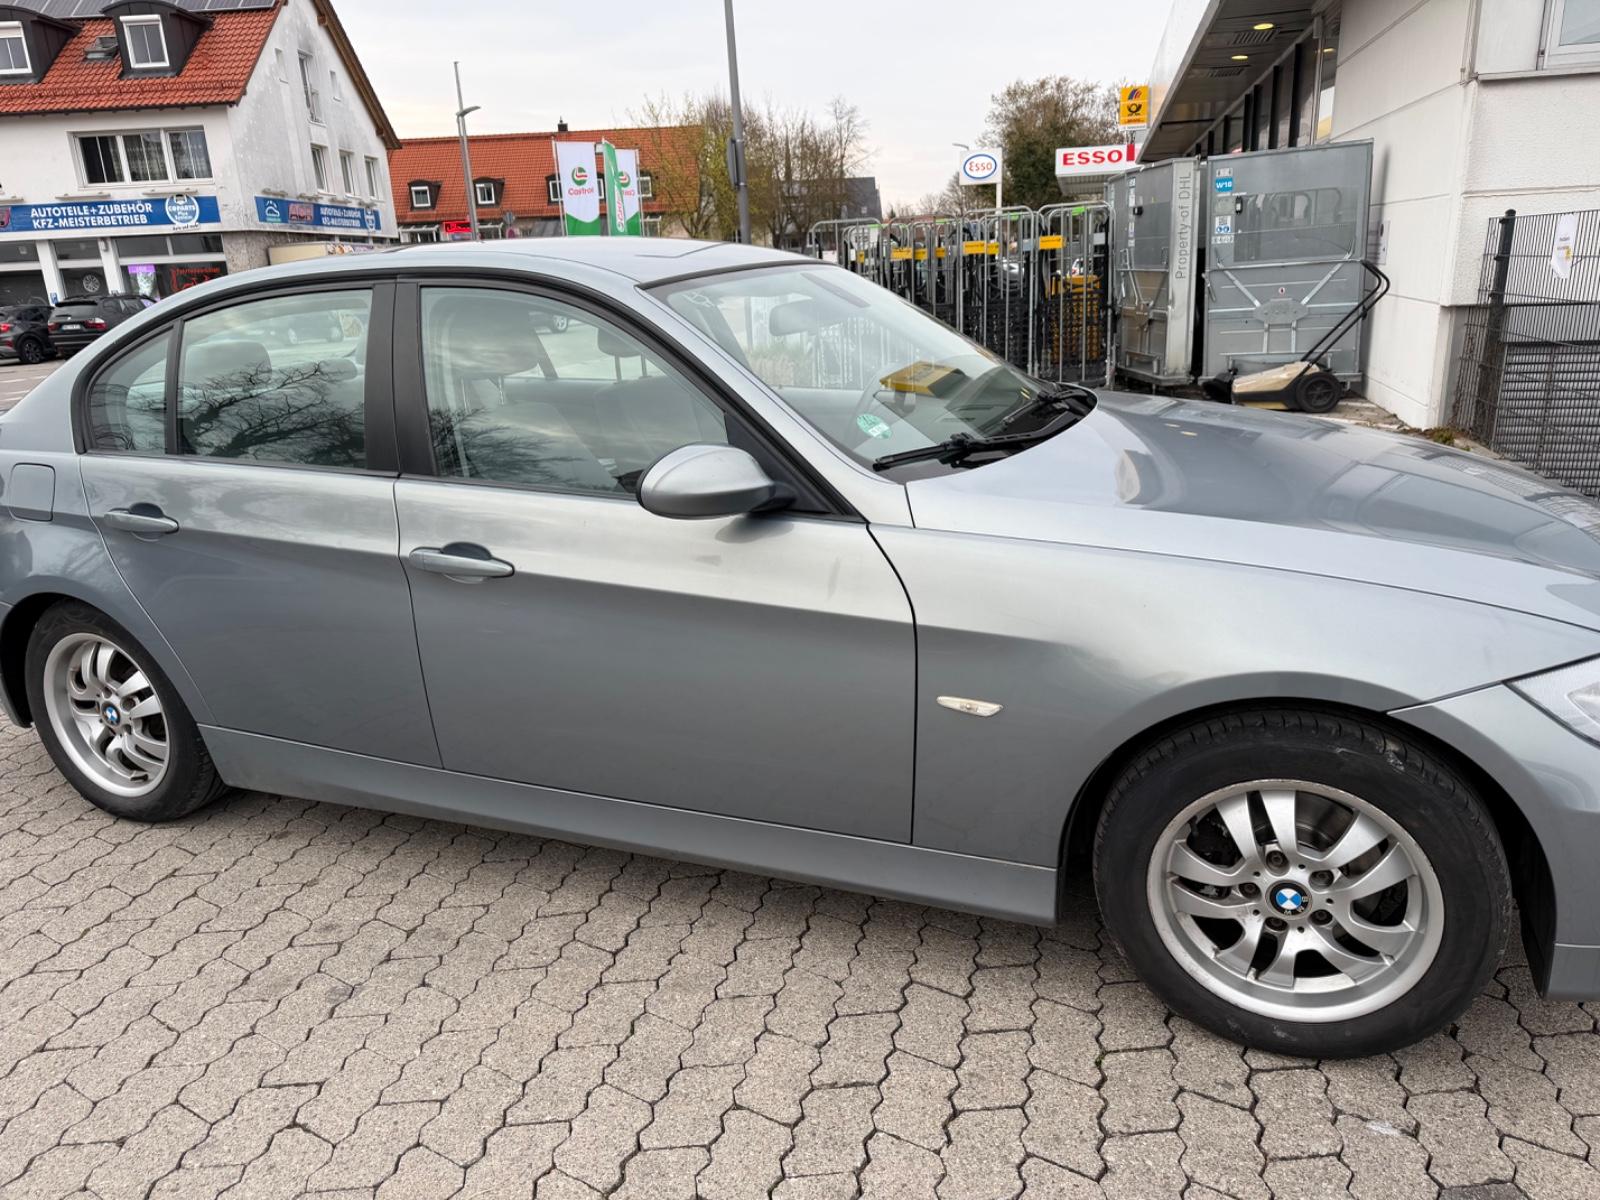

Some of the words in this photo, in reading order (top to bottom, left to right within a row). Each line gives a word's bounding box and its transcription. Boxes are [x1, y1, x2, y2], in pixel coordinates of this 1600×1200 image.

[1062, 149, 1123, 166] ESSO
[568, 187, 594, 196] Castrol
[1178, 171, 1191, 200] DHL
[31, 200, 153, 218] AUTOTEILE+ZUBEHÖR
[1178, 205, 1190, 218] of
[33, 214, 148, 229] KFZ-MEISTERBETRIEB
[1175, 223, 1191, 279] Property
